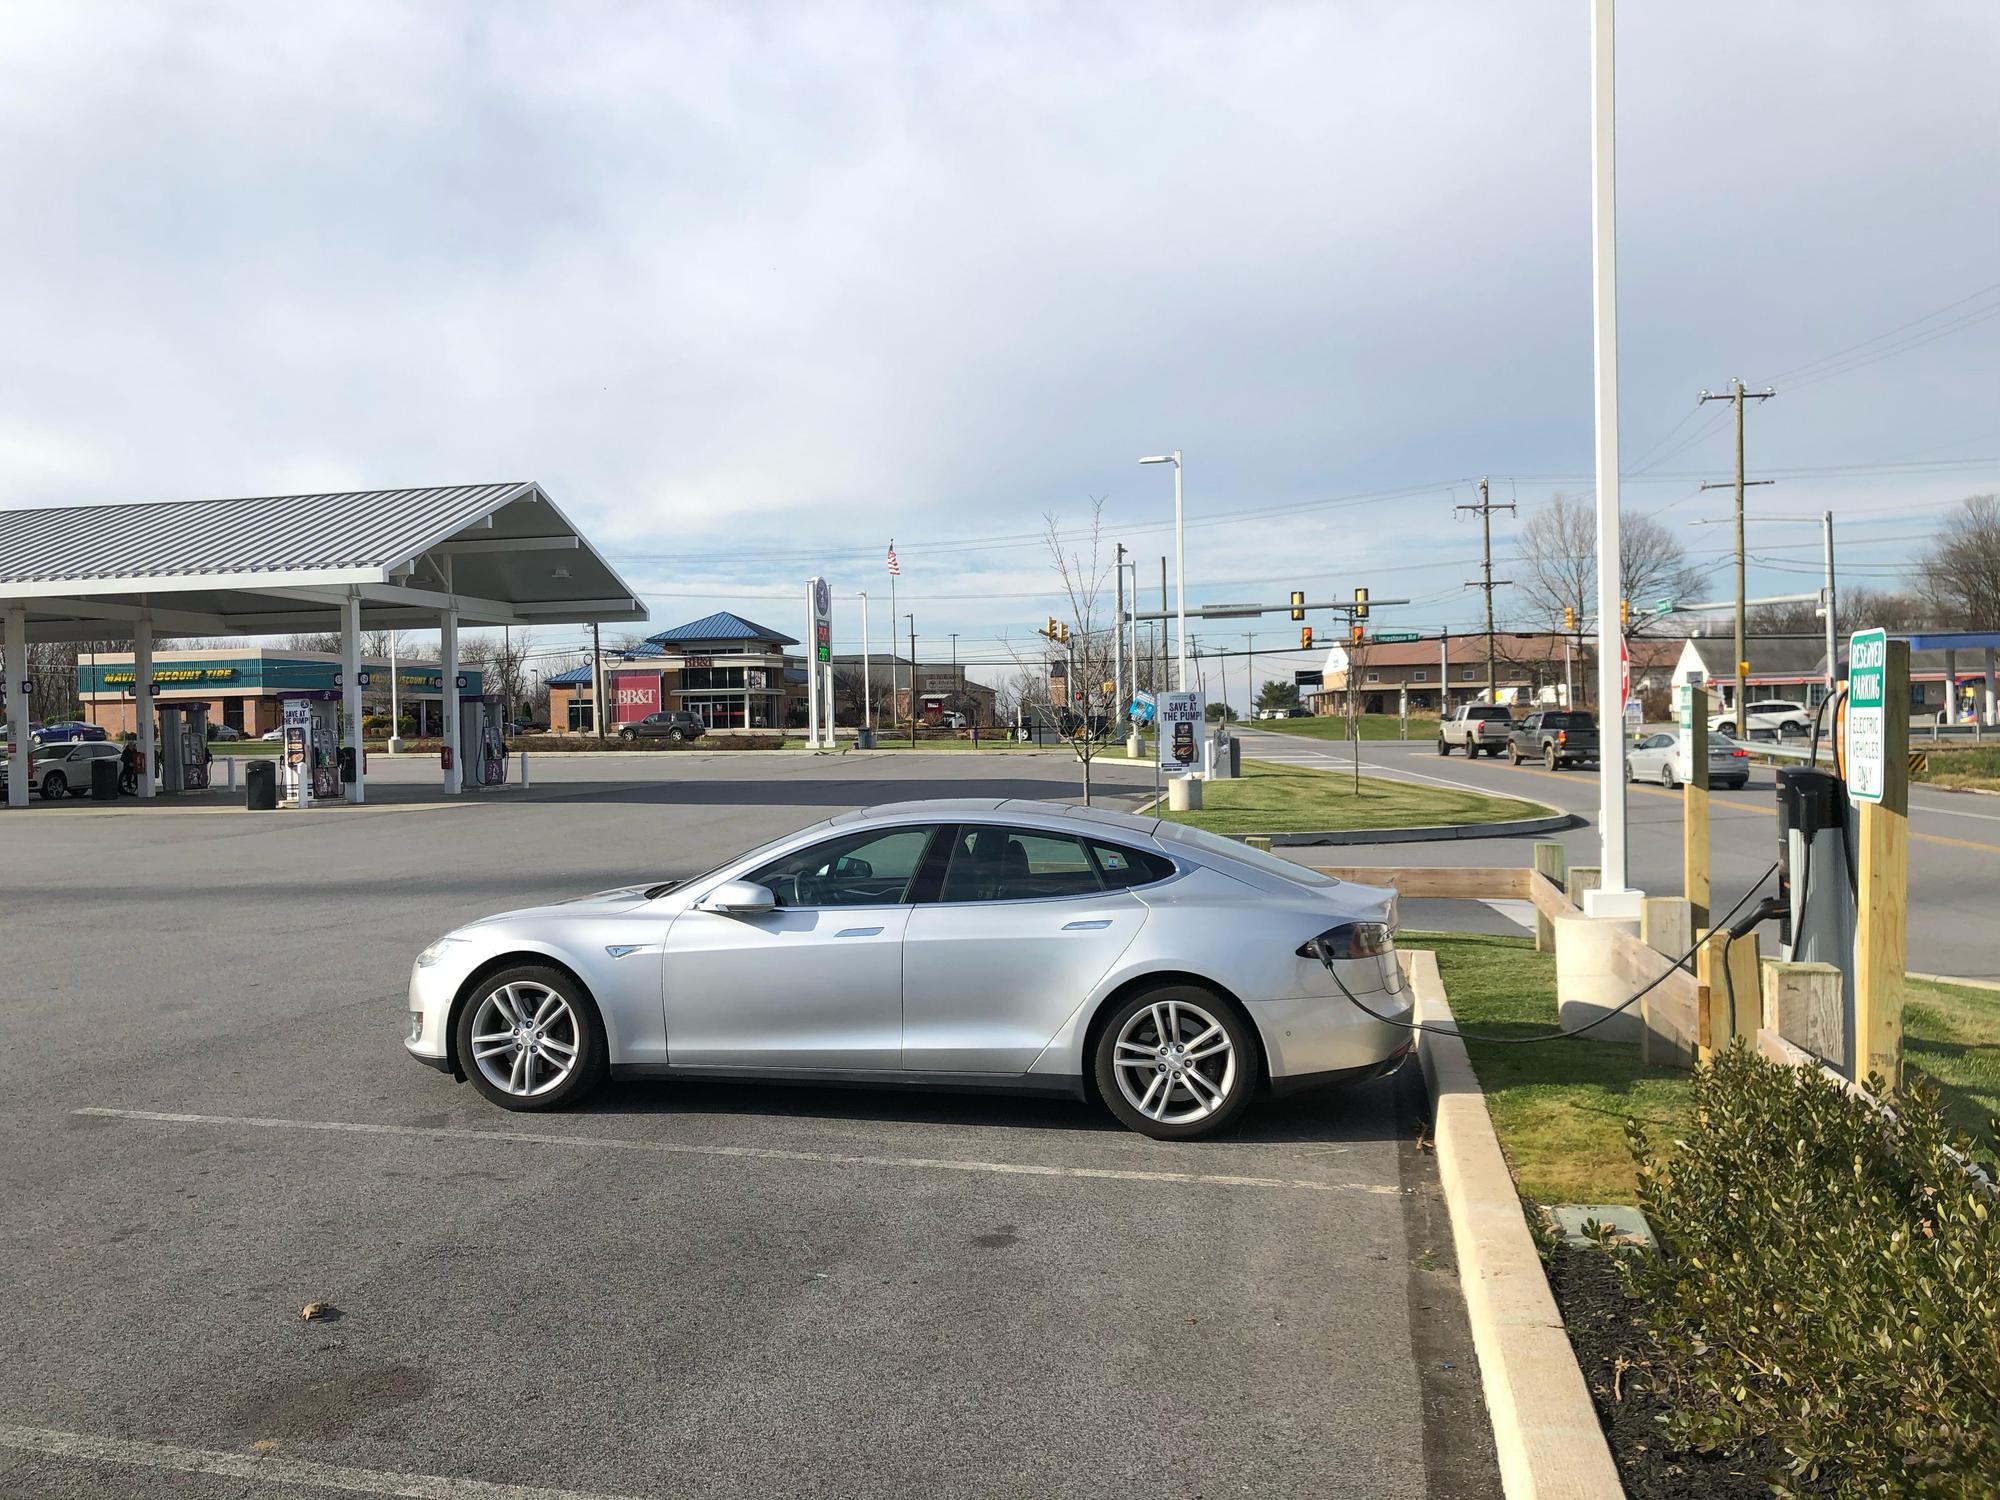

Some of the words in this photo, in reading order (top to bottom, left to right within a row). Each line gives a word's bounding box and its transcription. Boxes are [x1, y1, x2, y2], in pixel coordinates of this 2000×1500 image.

[1851, 641, 1883, 669] RESERVED
[104, 672, 136, 682] MAVI
[152, 669, 202, 680] ISCOUNT
[206, 668, 231, 679] TIRE
[1853, 674, 1880, 700] PARKING
[618, 688, 656, 704] BB&T
[1169, 702, 1187, 712] SAVE
[1190, 702, 1197, 711] AT
[1163, 712, 1178, 721] THE
[1180, 711, 1202, 720] PUMP!
[1853, 716, 1879, 734] ELECTRIC
[1852, 742, 1879, 759] VEHICLES
[1858, 765, 1872, 783] ONLY
